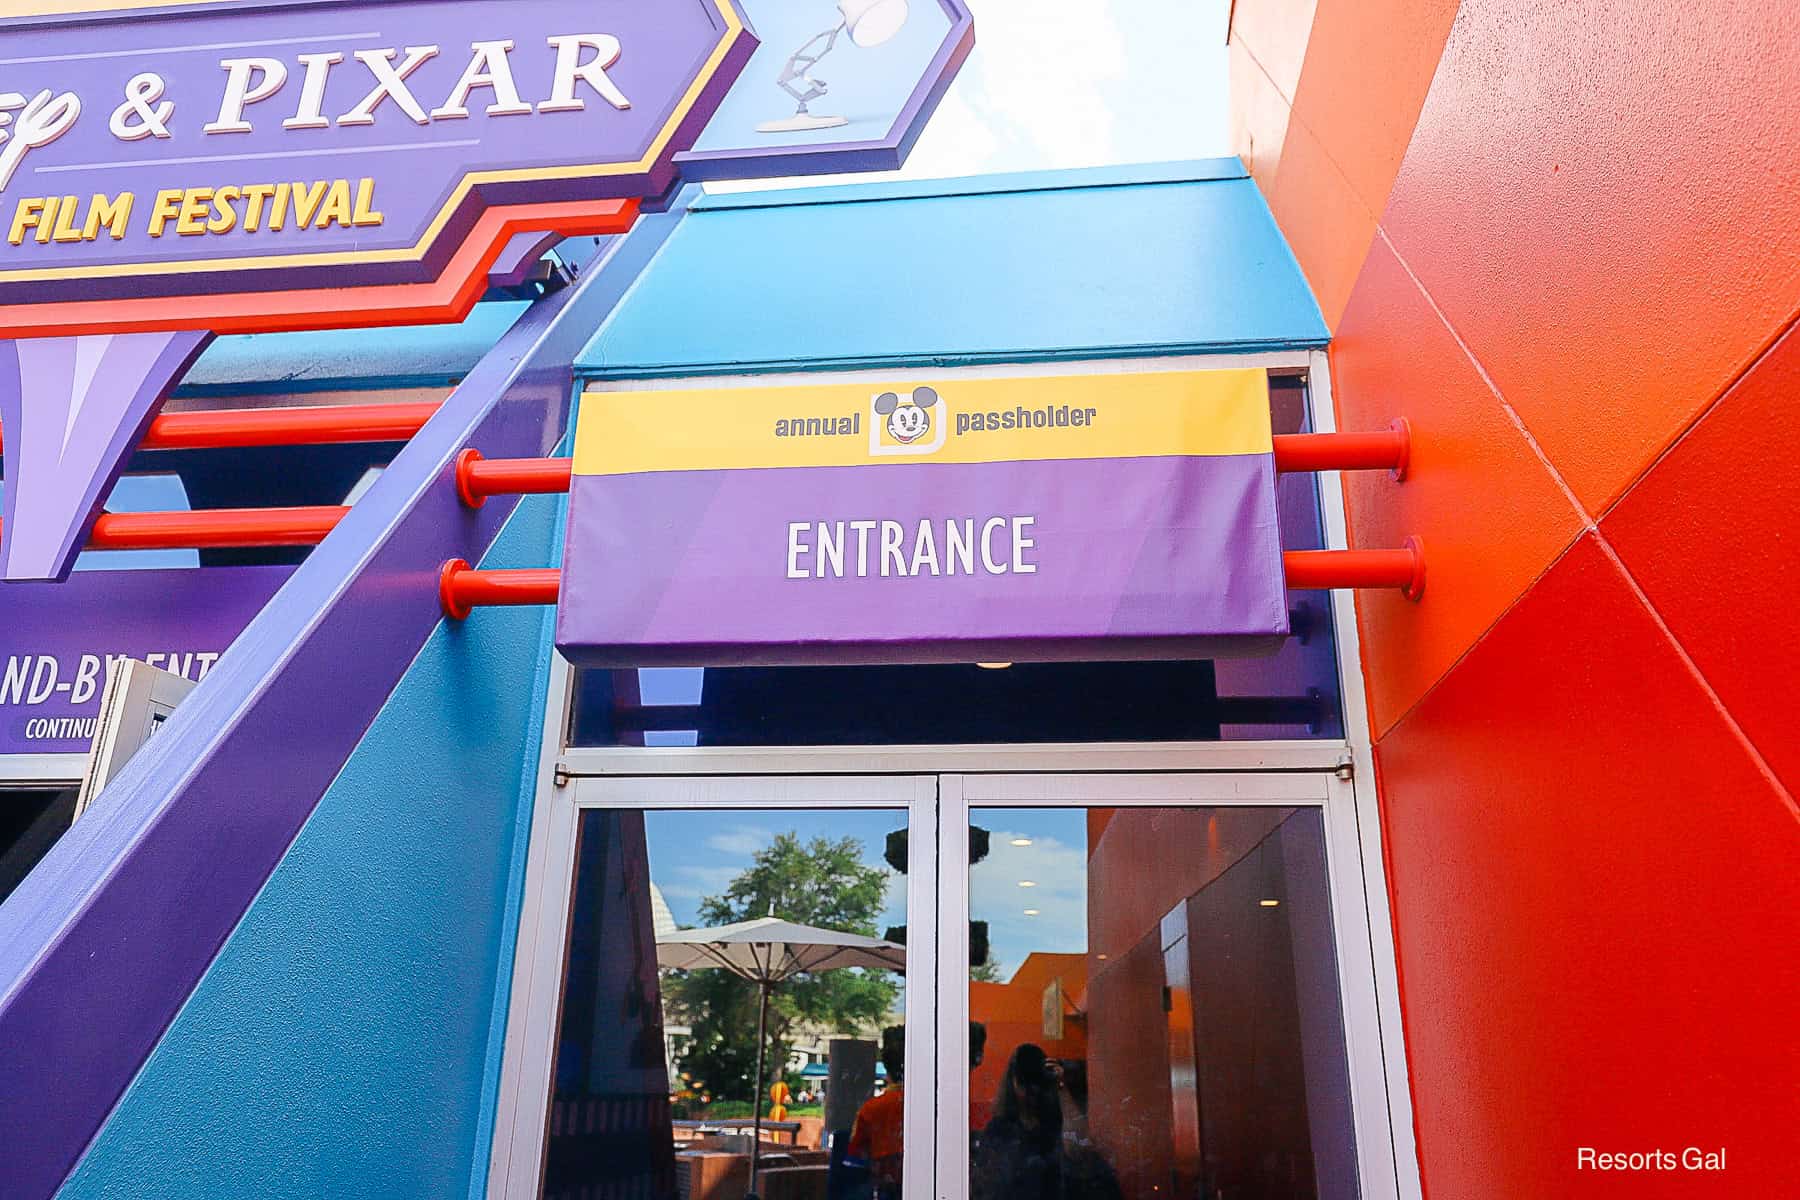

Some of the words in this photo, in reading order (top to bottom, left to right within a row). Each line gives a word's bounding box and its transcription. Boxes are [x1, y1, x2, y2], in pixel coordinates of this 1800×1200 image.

[109, 72, 175, 141] &
[202, 32, 632, 135] PIXAR
[8, 191, 134, 245] FILM
[147, 177, 384, 238] FESTIVAL
[775, 412, 860, 437] annual
[956, 404, 1097, 435] passholder
[786, 516, 1037, 579] ENTRANCE
